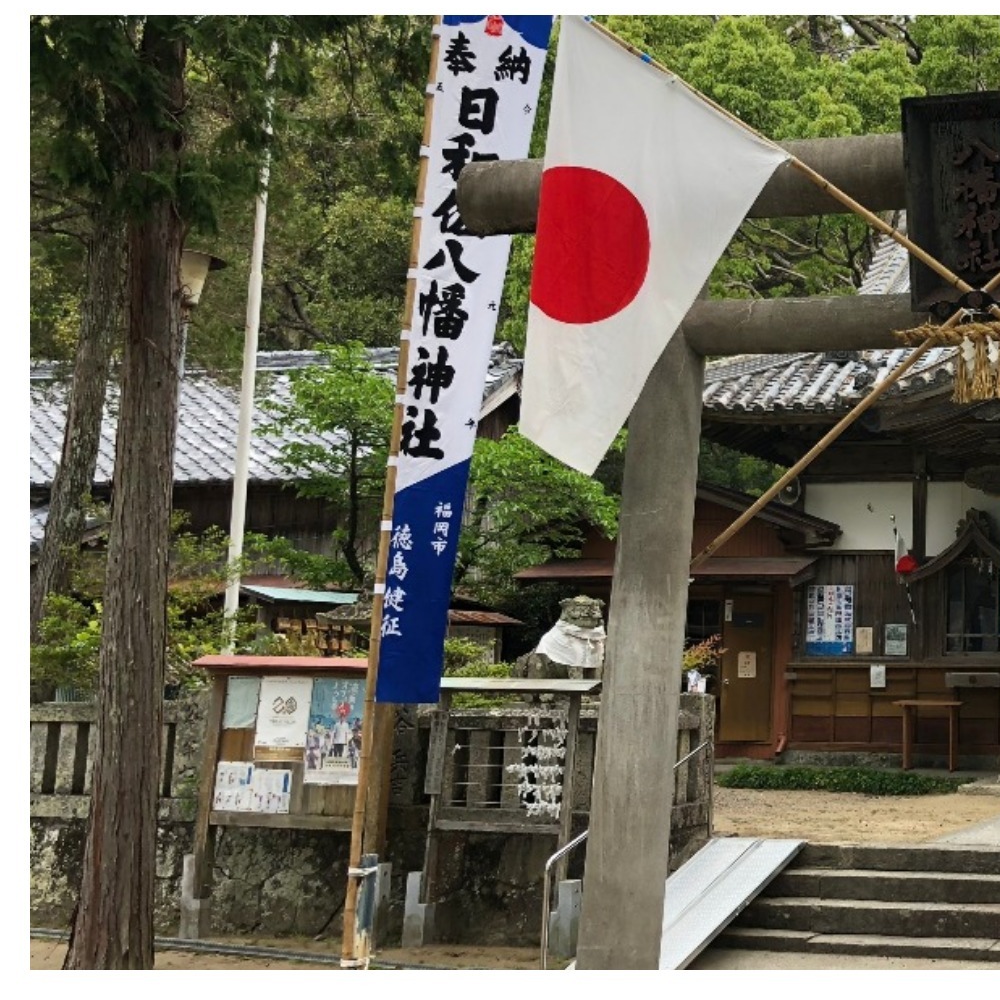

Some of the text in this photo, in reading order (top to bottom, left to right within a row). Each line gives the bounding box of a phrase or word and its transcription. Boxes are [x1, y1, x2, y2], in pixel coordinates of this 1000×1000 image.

[443, 31, 531, 84] 奉 納
[431, 502, 453, 556] 福岡市
